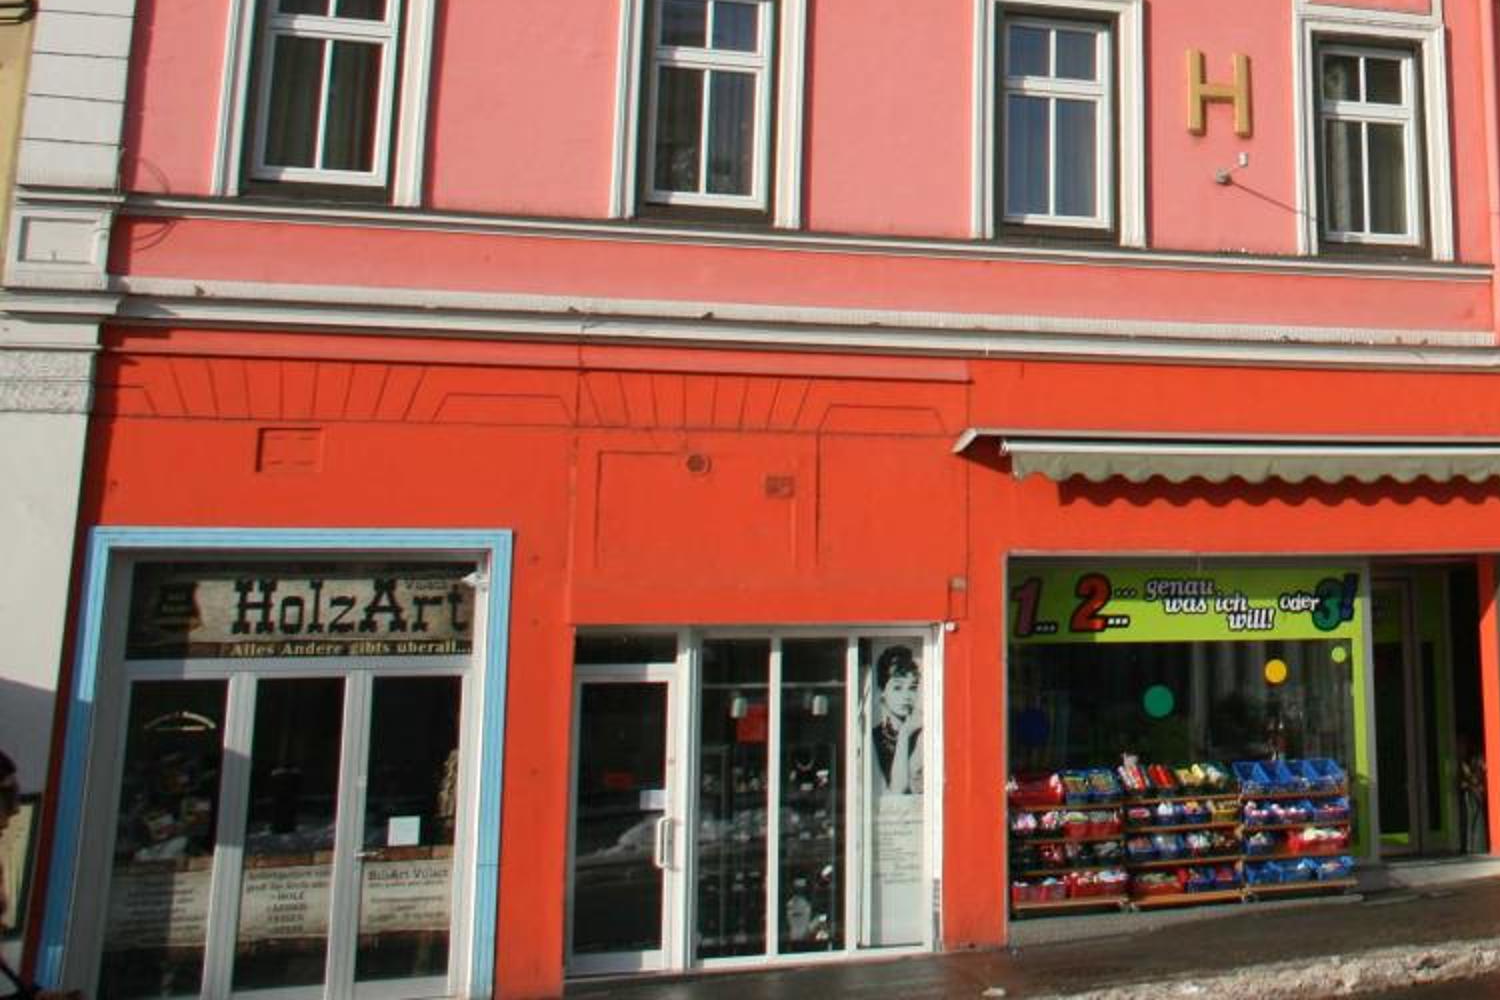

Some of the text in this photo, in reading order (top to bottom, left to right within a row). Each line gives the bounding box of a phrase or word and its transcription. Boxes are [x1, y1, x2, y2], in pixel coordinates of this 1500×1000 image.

[1145, 577, 1216, 602] genau
[231, 578, 472, 635] HolzArt
[1163, 593, 1249, 613] was ich
[1279, 591, 1321, 611] oder
[1227, 608, 1276, 631] will!
[230, 643, 275, 657] Alles
[281, 642, 345, 656] Andere
